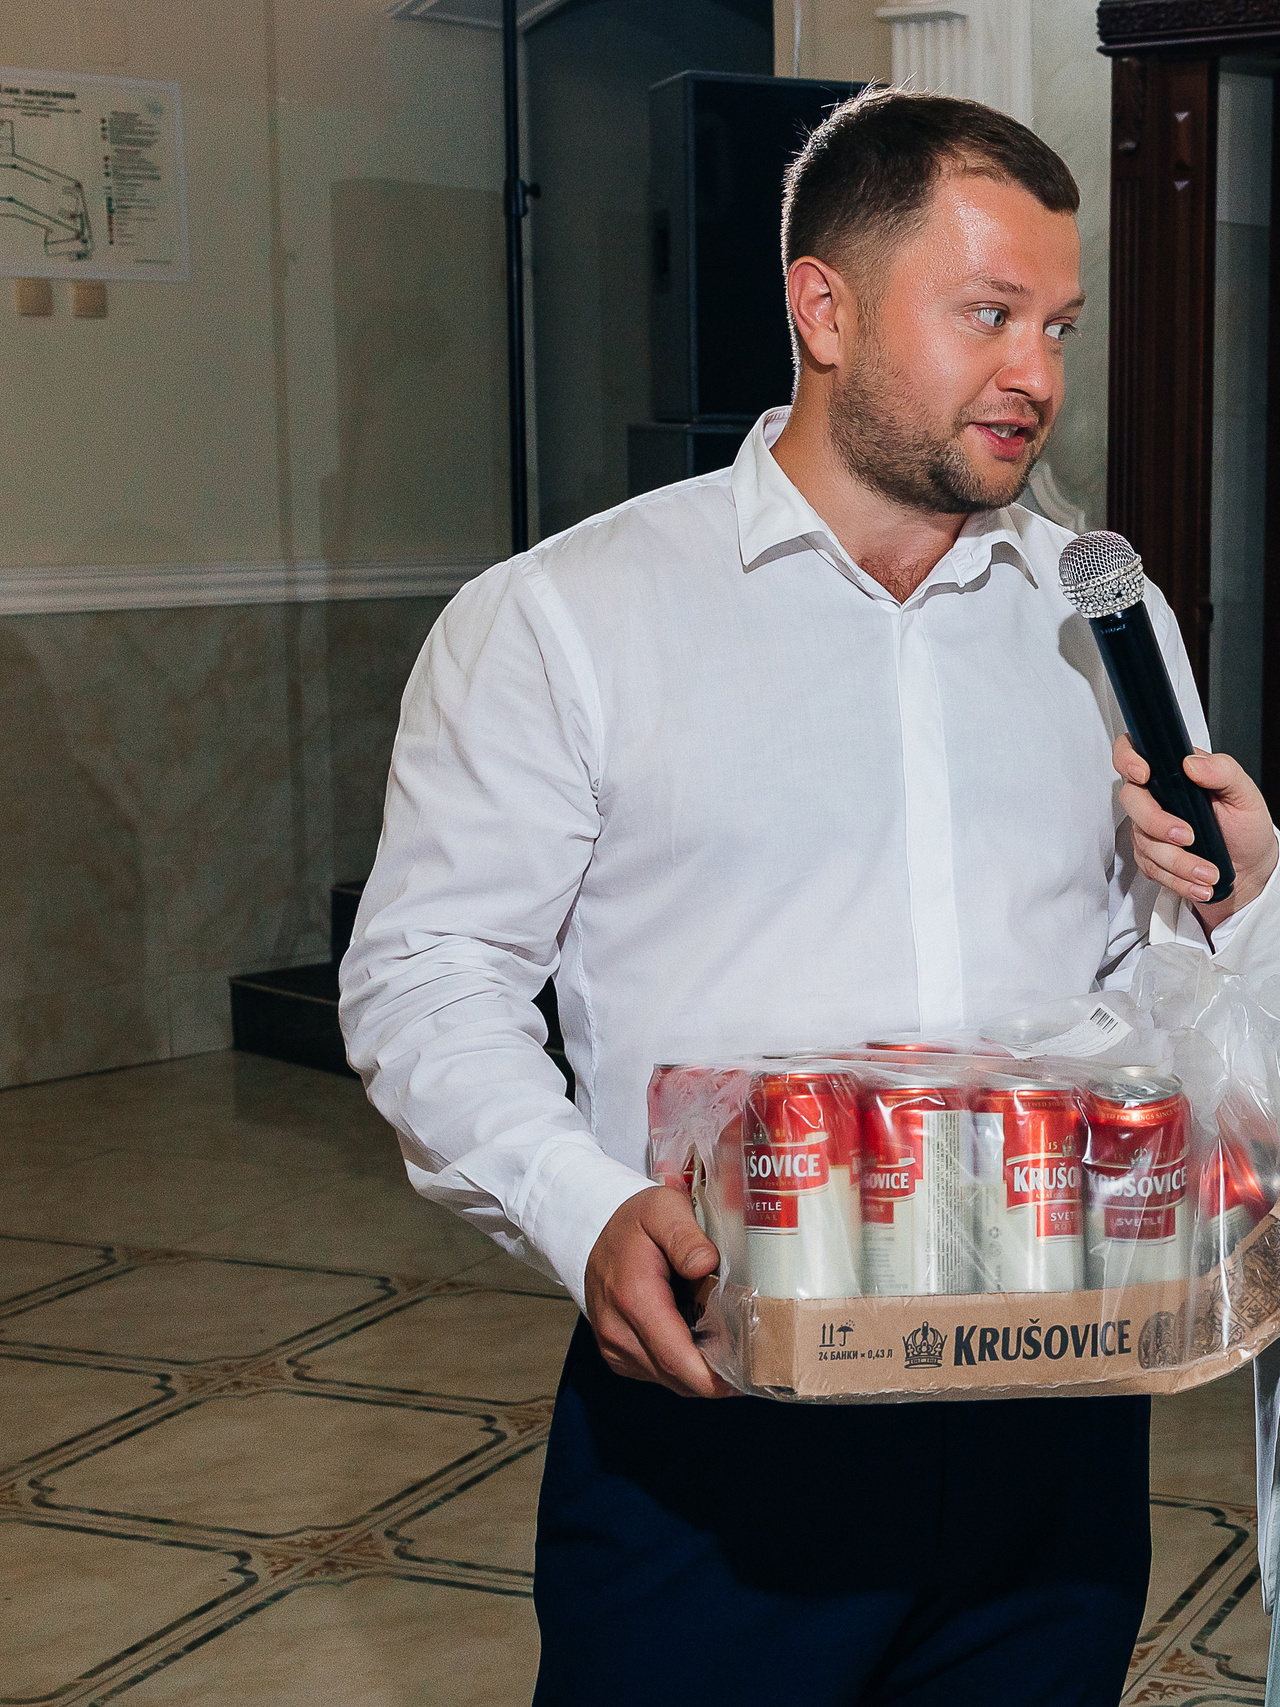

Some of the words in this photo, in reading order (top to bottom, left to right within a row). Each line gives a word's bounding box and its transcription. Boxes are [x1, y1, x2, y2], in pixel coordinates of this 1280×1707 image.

[1048, 1141, 1058, 1150] 15
[954, 1318, 1132, 1367] KRUŠOVICE
[818, 1351, 828, 1361] 24
[830, 1350, 858, 1361] БАНКИ
[867, 1349, 885, 1360] 0,43
[886, 1348, 893, 1358] Л
